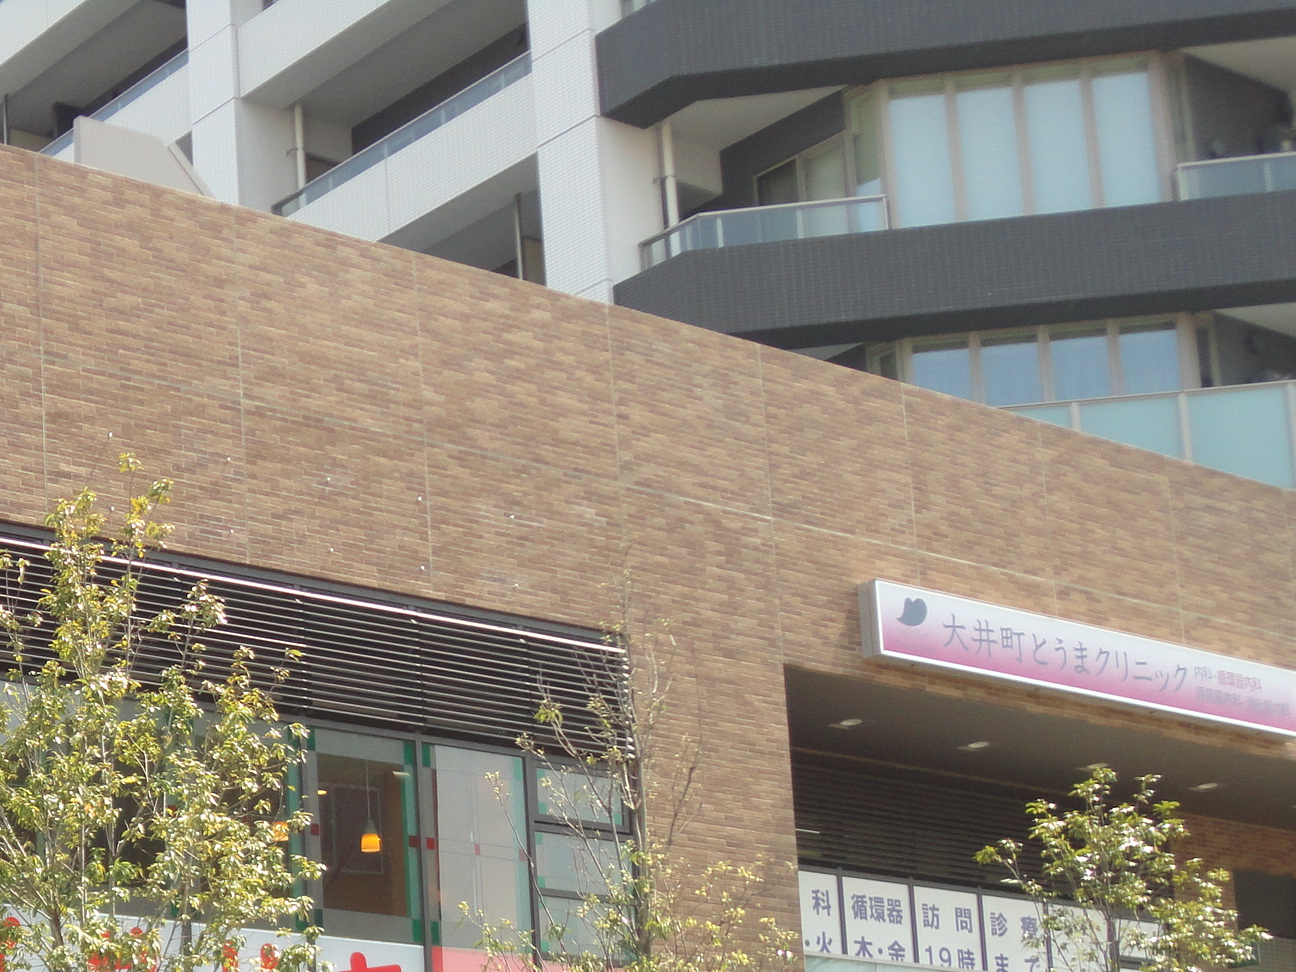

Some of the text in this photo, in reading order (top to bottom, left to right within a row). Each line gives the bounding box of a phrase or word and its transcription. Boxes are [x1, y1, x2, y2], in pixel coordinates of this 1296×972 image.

[942, 612, 1188, 693] 大井町とうまクリニック
